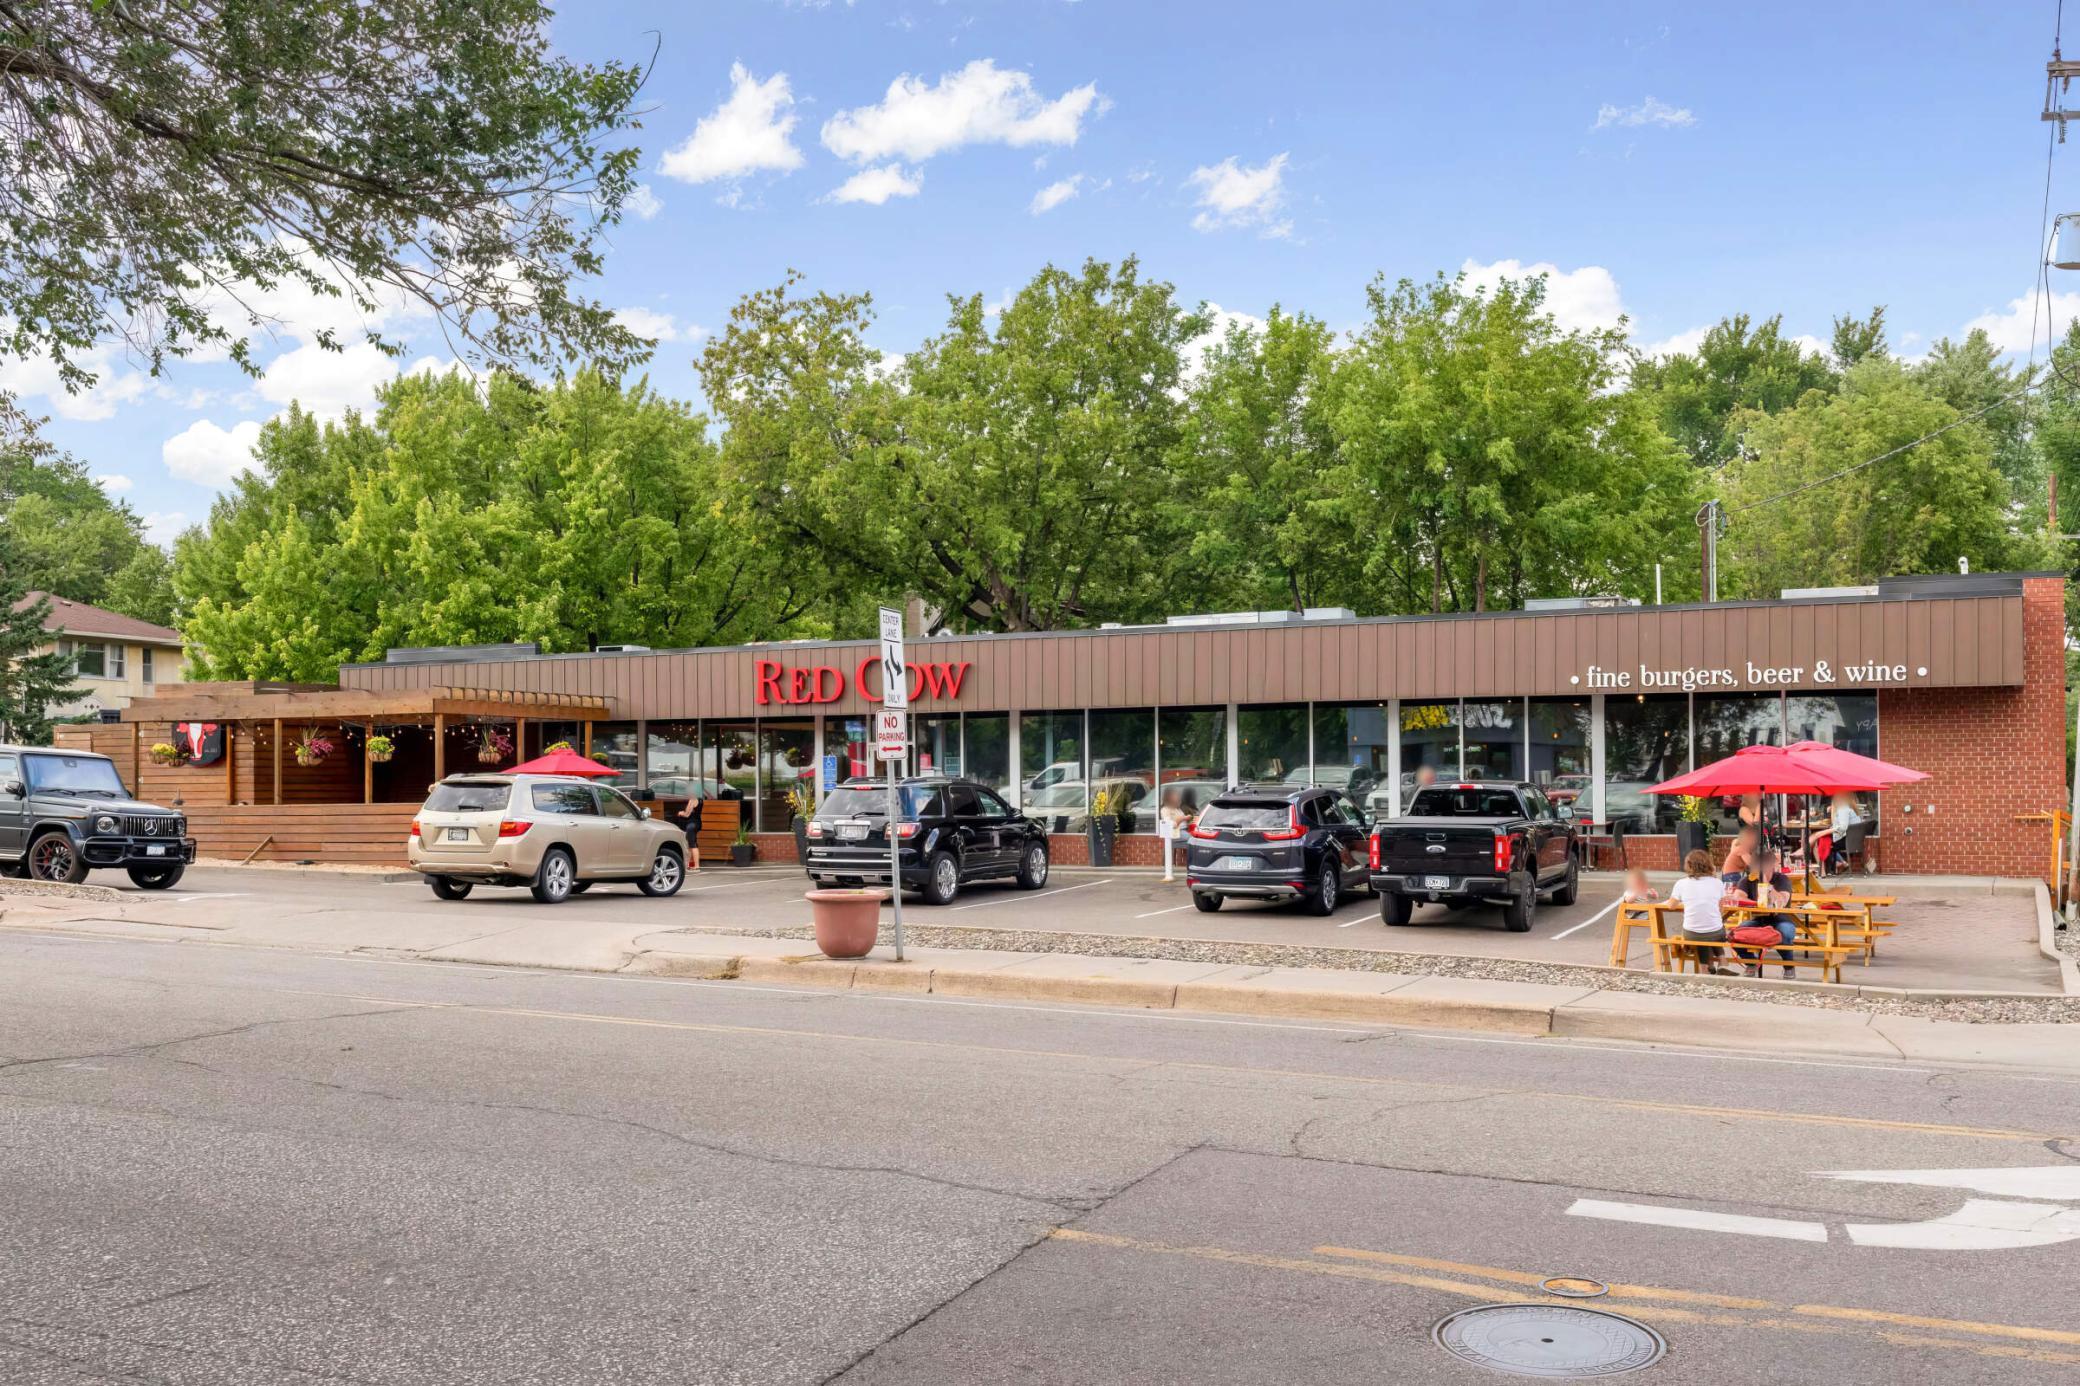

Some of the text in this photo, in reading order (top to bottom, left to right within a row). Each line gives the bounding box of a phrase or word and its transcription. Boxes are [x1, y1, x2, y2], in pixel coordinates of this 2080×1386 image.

[882, 614, 899, 626] CENTER
[885, 628, 897, 638] LANE
[1586, 659, 1907, 691] fine burgers, beer & wine
[755, 660, 846, 705] RED
[884, 716, 898, 728] NO
[878, 732, 905, 741] PARKING
